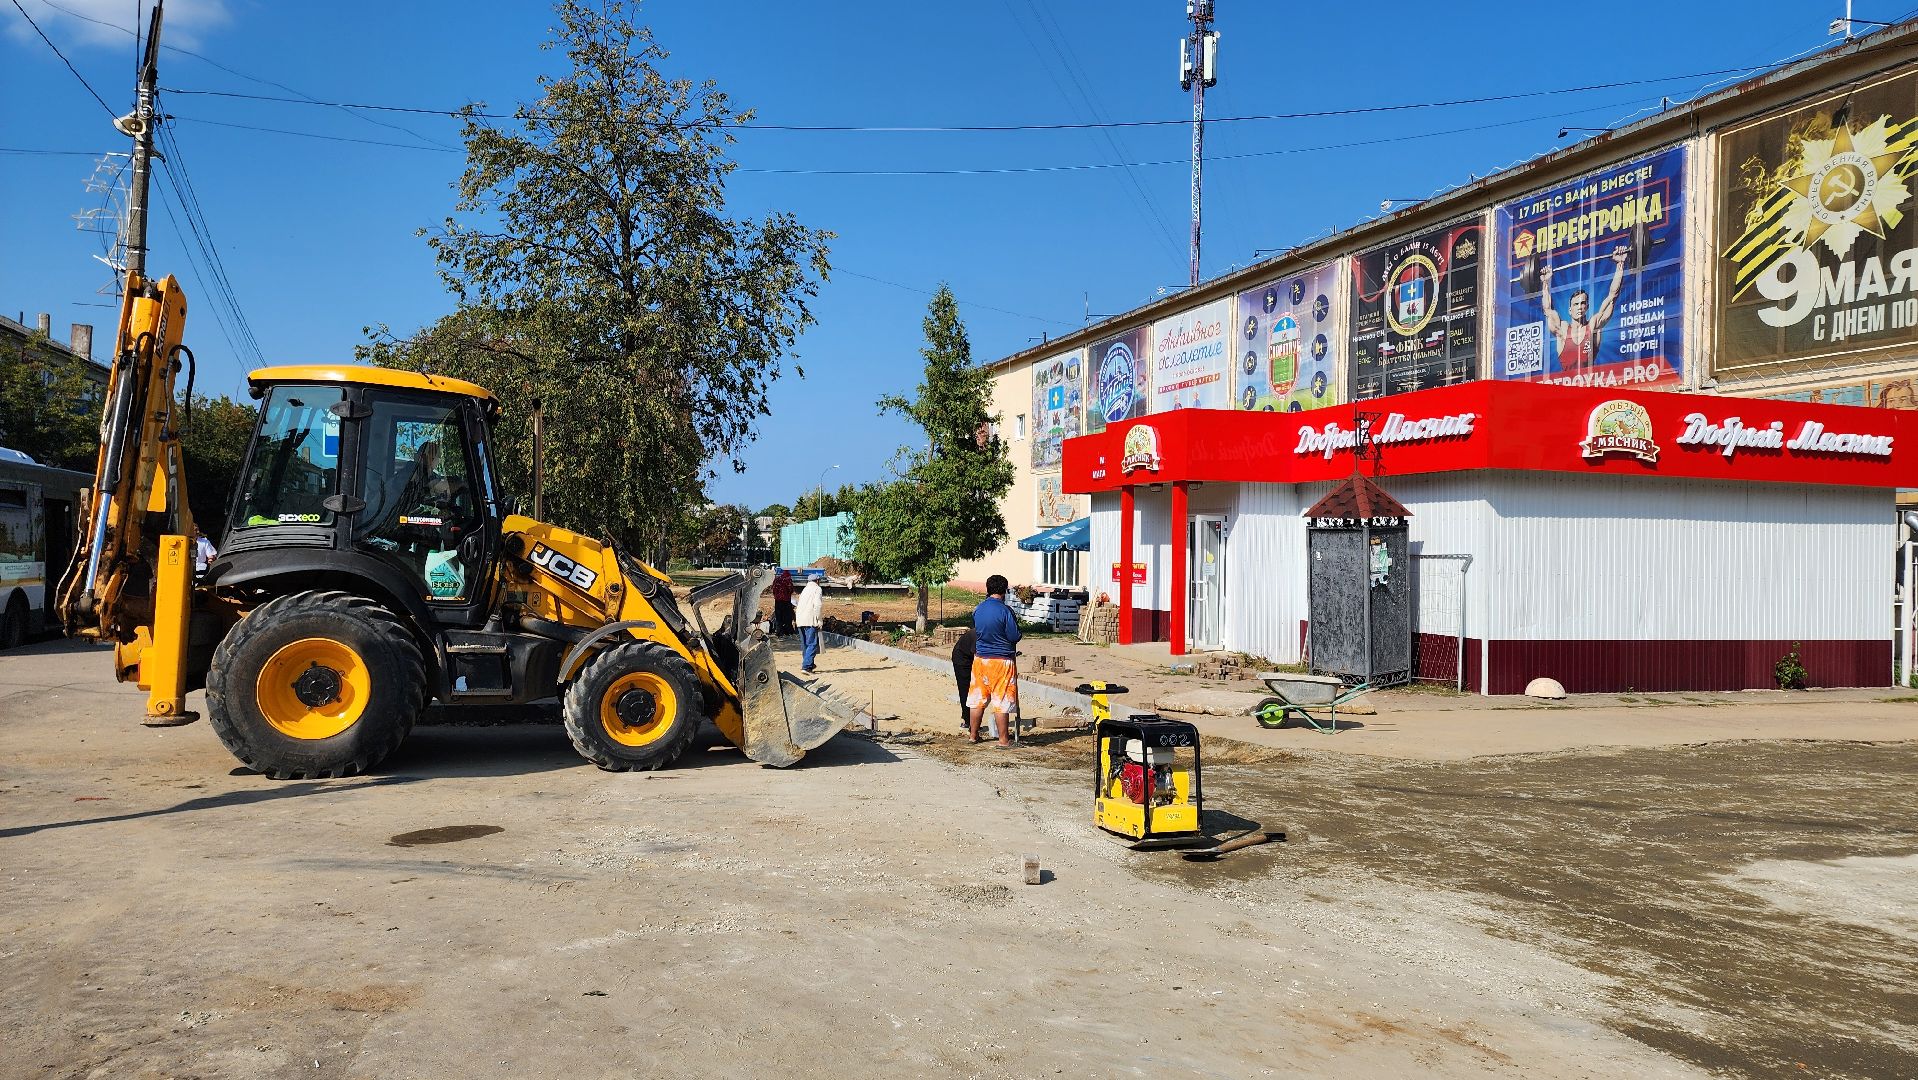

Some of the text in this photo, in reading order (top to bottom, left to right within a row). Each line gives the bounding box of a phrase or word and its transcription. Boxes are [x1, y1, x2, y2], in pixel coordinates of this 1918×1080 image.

[1518, 205, 1530, 219] 17
[1531, 200, 1552, 216] ЛЕТ
[1565, 183, 1598, 205] ВАМИ
[1601, 165, 1653, 193] ВМЕСТЕ!
[1536, 191, 1663, 253] ПЕРЕСТРОЙКА
[1756, 245, 1918, 327] 9 МАЯ
[1620, 296, 1665, 313] К НОВЫМ
[1620, 310, 1665, 327] ПОБЕДАМ
[1813, 314, 1826, 341] С
[1830, 303, 1885, 342] ДНЕМ
[1620, 324, 1665, 340] В ТРУДЕ И
[1620, 339, 1658, 354] СПОРТЕ!
[1373, 412, 1477, 445] Мясник
[1597, 436, 1647, 451] МЯСНИК
[1677, 412, 1894, 457] Добрый Мясник
[530, 543, 596, 589] JCB
